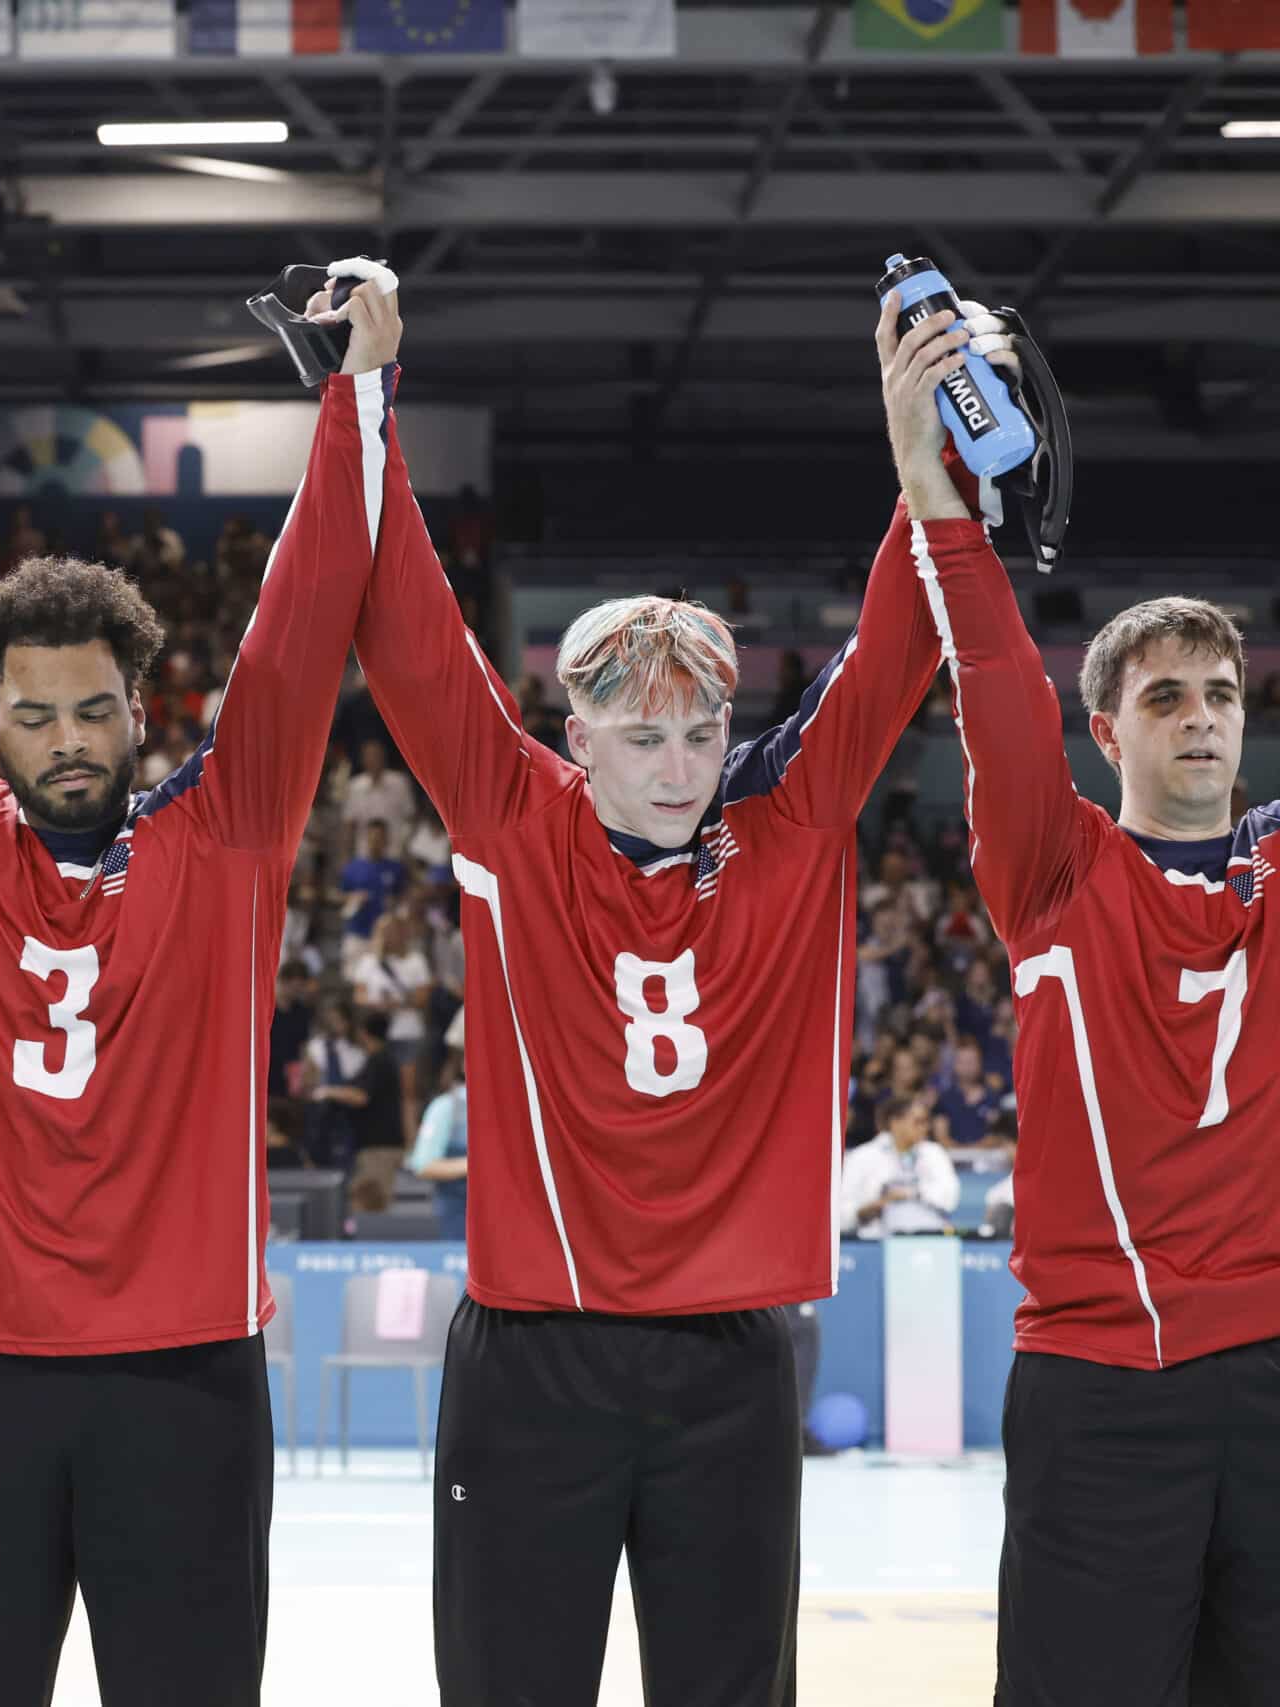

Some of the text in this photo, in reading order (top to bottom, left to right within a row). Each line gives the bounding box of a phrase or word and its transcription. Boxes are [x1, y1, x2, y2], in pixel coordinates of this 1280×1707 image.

[13, 936, 99, 1099] 3
[614, 949, 707, 1097] 8
[1178, 947, 1248, 1129] 7
